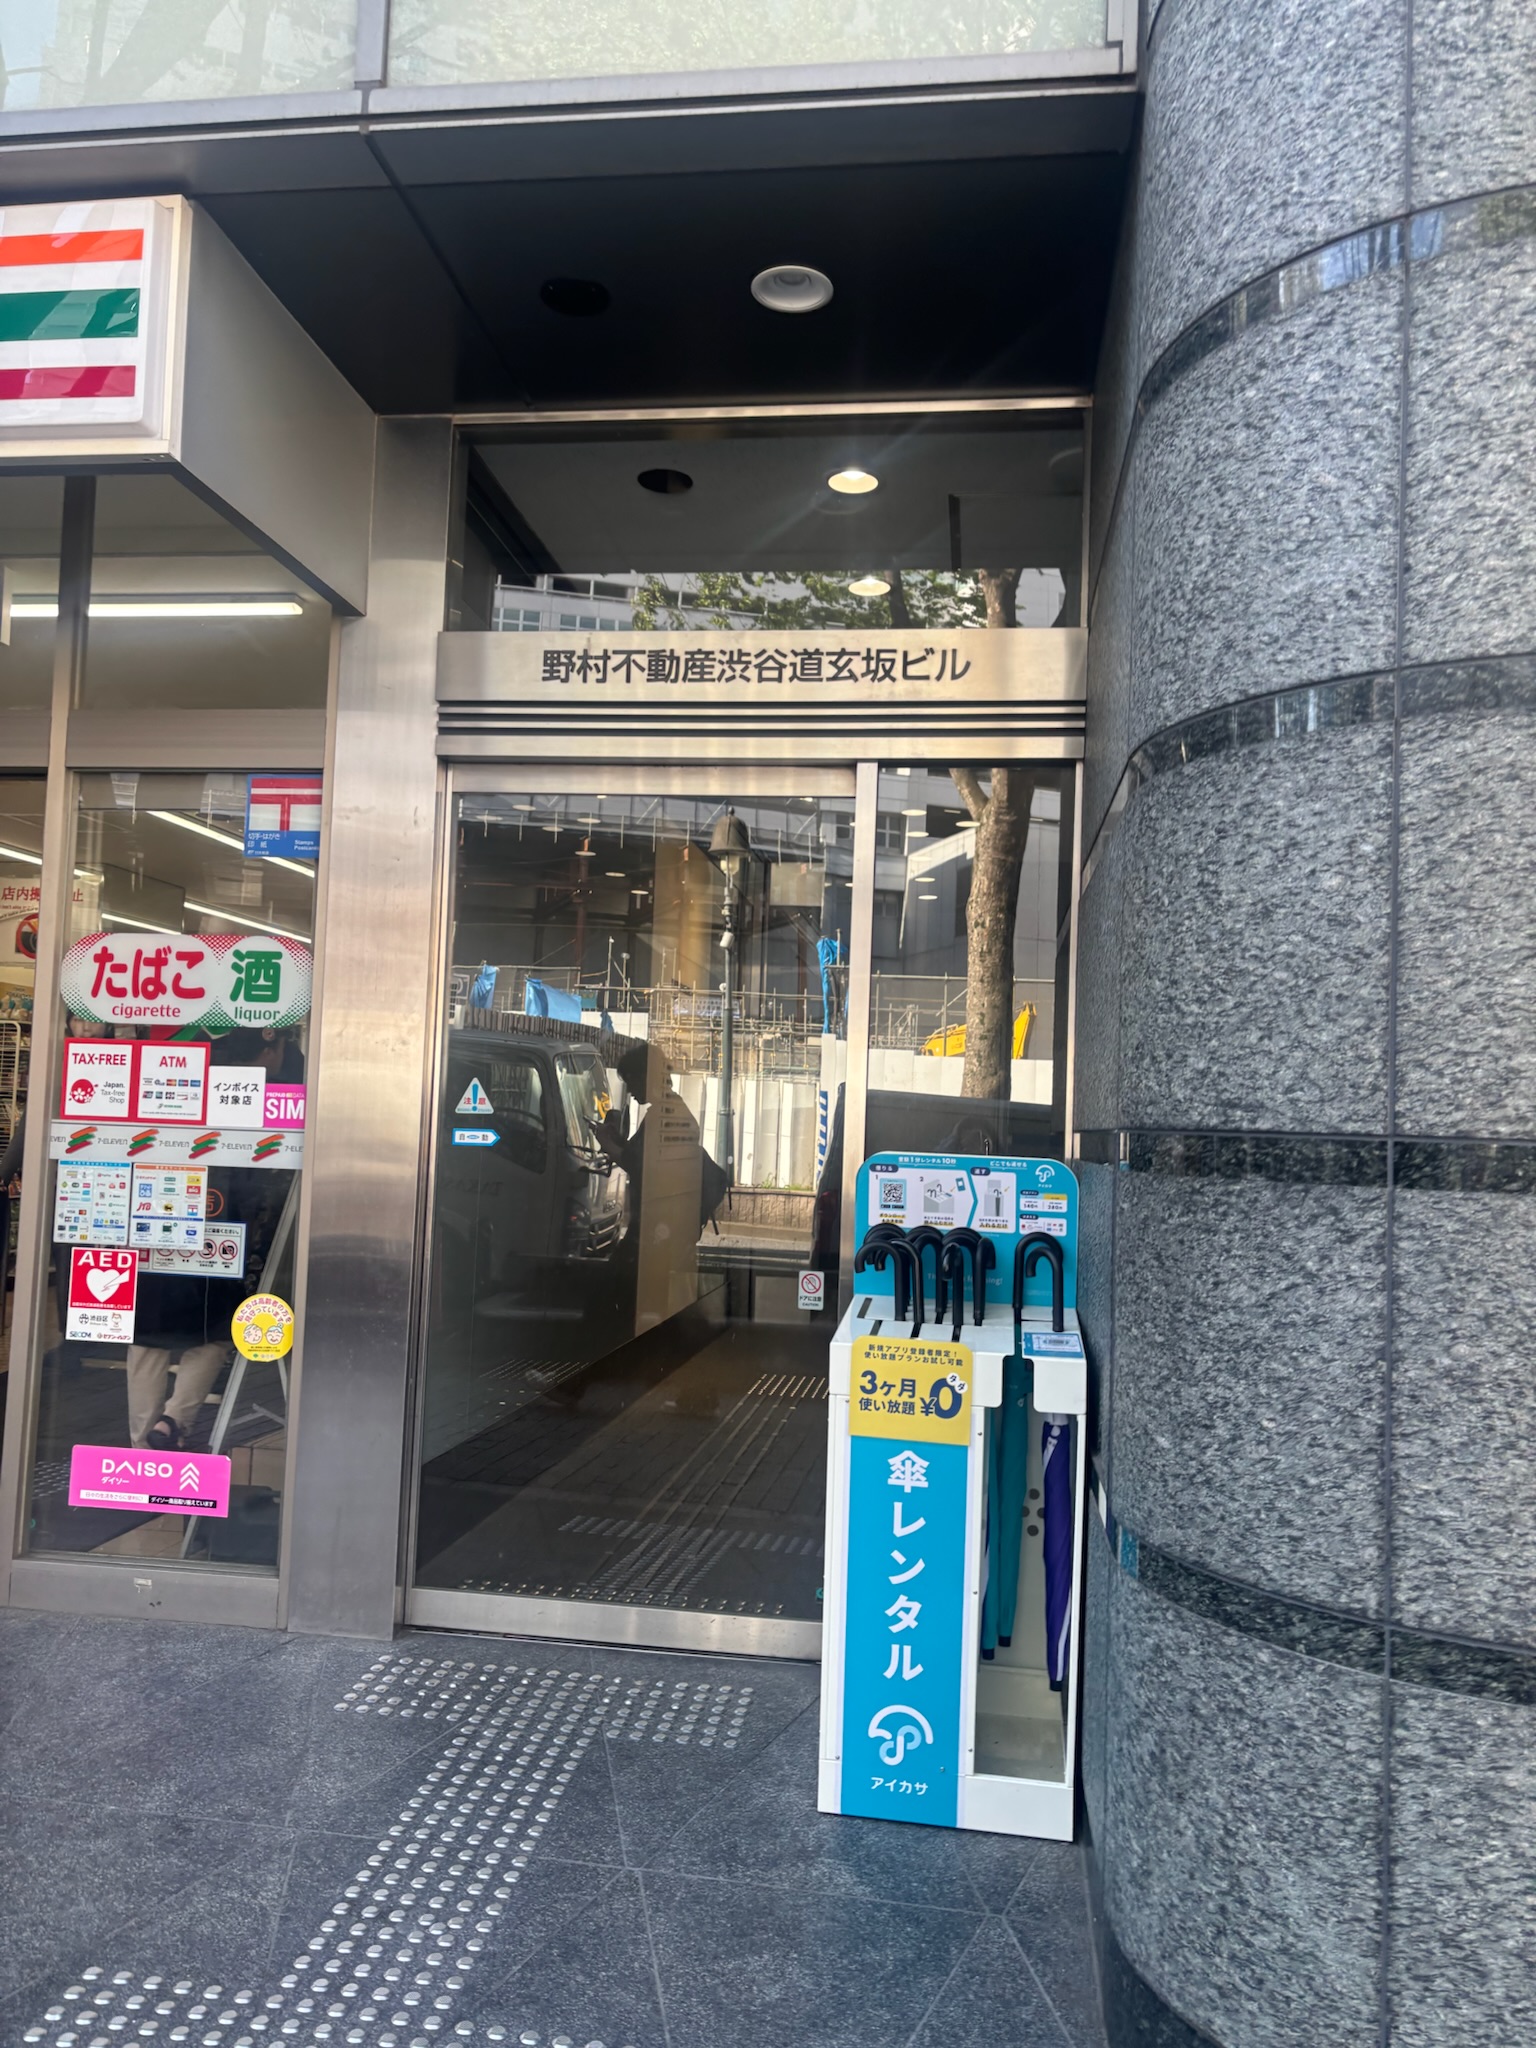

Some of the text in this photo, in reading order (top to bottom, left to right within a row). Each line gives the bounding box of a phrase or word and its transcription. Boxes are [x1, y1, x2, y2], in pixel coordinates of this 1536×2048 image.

[541, 648, 973, 684] 野村不動産渋谷道玄坂ビル
[91, 946, 205, 1000] たばこ
[229, 949, 283, 1003] 酒
[112, 1004, 181, 1018] cigarette
[234, 1007, 281, 1022] liquor
[72, 1053, 127, 1066] TAX-FREE
[159, 1056, 187, 1068] ATM
[213, 1083, 259, 1092] インボイス
[219, 1095, 252, 1105] 対象店
[265, 1098, 305, 1120] SIM
[77, 1251, 132, 1268] AED
[859, 1397, 916, 1415] 使い放題
[102, 1459, 173, 1478] DAISO
[101, 1476, 130, 1485] ダイソー
[882, 1449, 931, 1682] 傘レンタル
[870, 1776, 929, 1796] アイカサ
